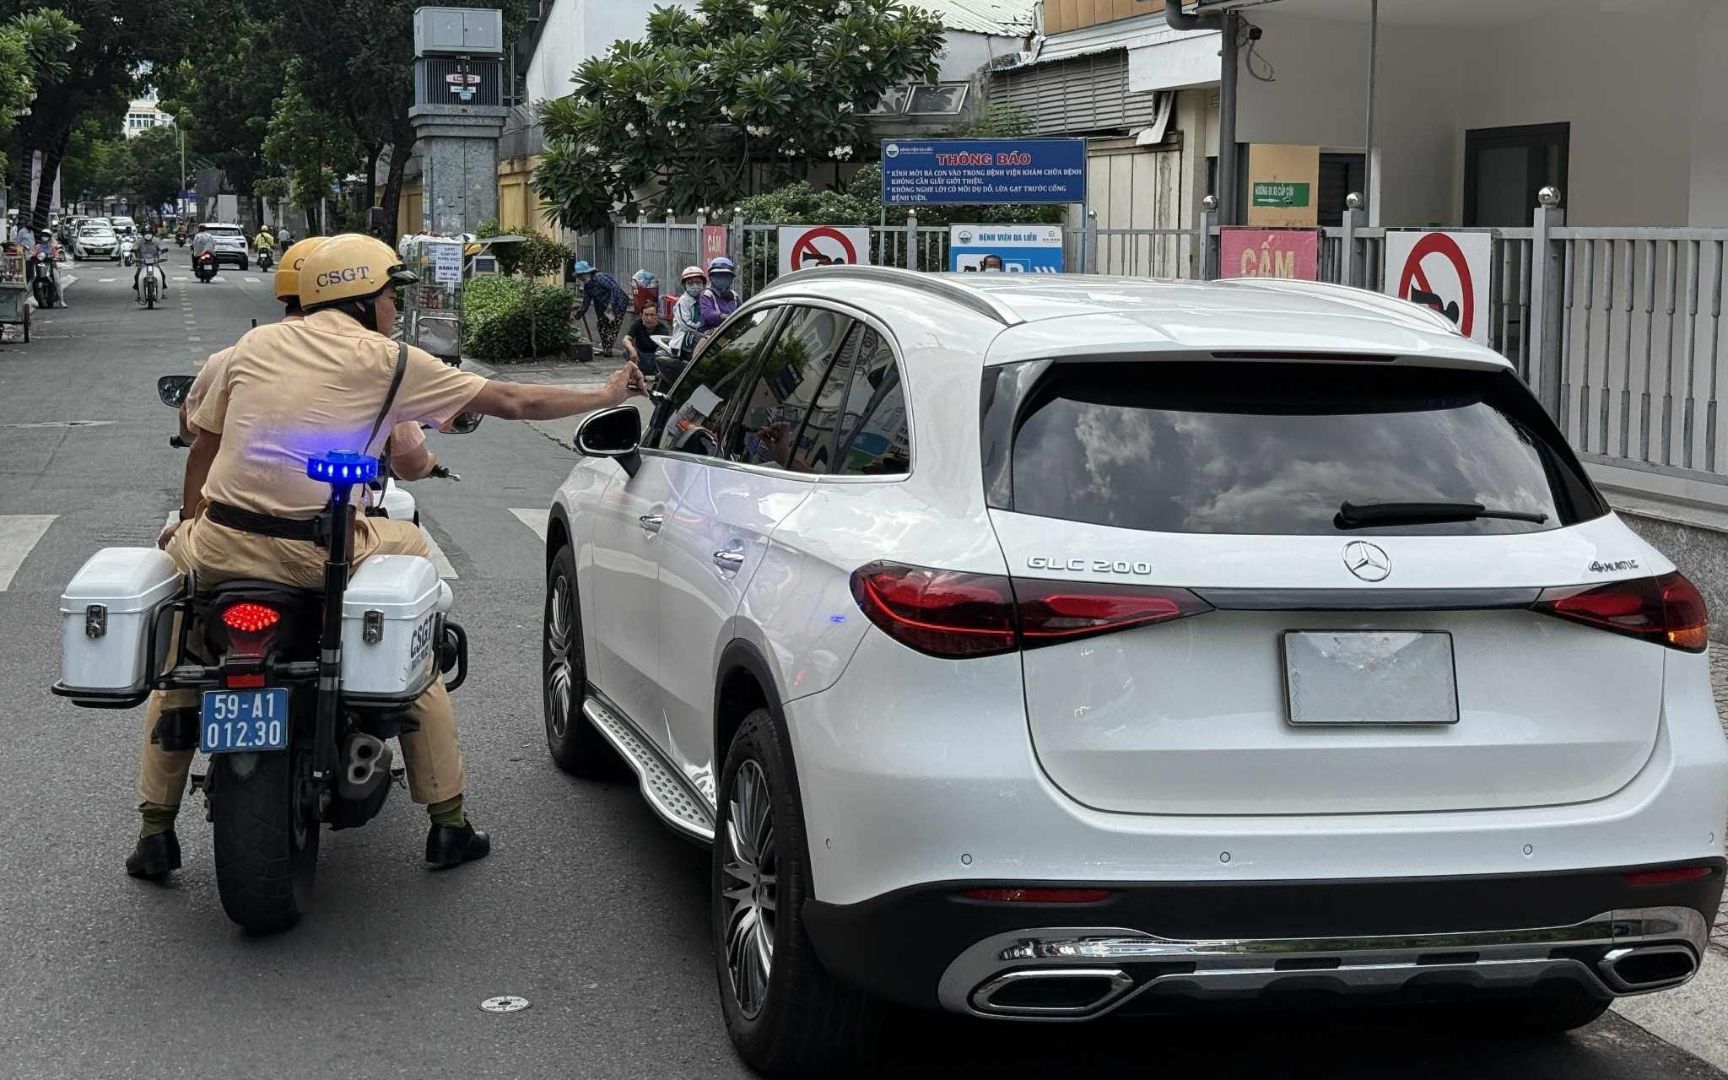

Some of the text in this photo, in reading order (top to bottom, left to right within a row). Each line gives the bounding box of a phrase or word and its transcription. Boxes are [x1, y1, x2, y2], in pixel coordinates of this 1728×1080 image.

[936, 150, 1032, 166] THÔNG BÁO
[1240, 234, 1294, 278] CẤM
[316, 265, 369, 288] CSGT
[1027, 556, 1152, 575] GLC 200
[410, 612, 434, 659] CSGT
[214, 692, 274, 719] 59-A1
[207, 720, 281, 748] 012.30
